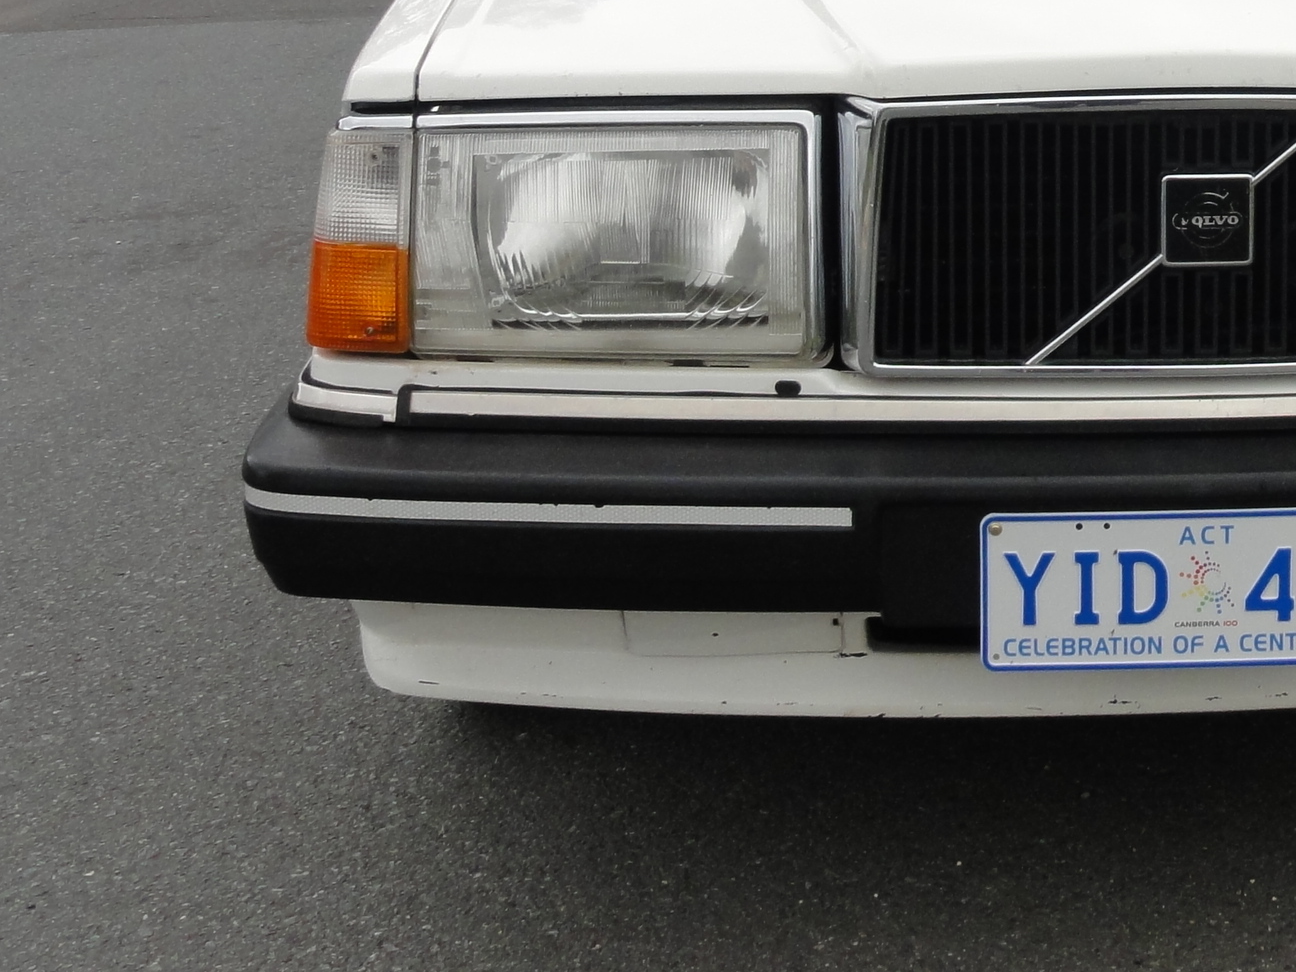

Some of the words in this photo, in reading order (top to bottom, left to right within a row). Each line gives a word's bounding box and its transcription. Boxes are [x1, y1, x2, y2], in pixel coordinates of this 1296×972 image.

[1178, 524, 1235, 546] ACT
[1003, 550, 1169, 626] YID
[1174, 620, 1220, 628] CANBERRA
[1003, 635, 1162, 658] CELEBRATION
[1173, 635, 1204, 655] OF
[1213, 634, 1230, 654] A
